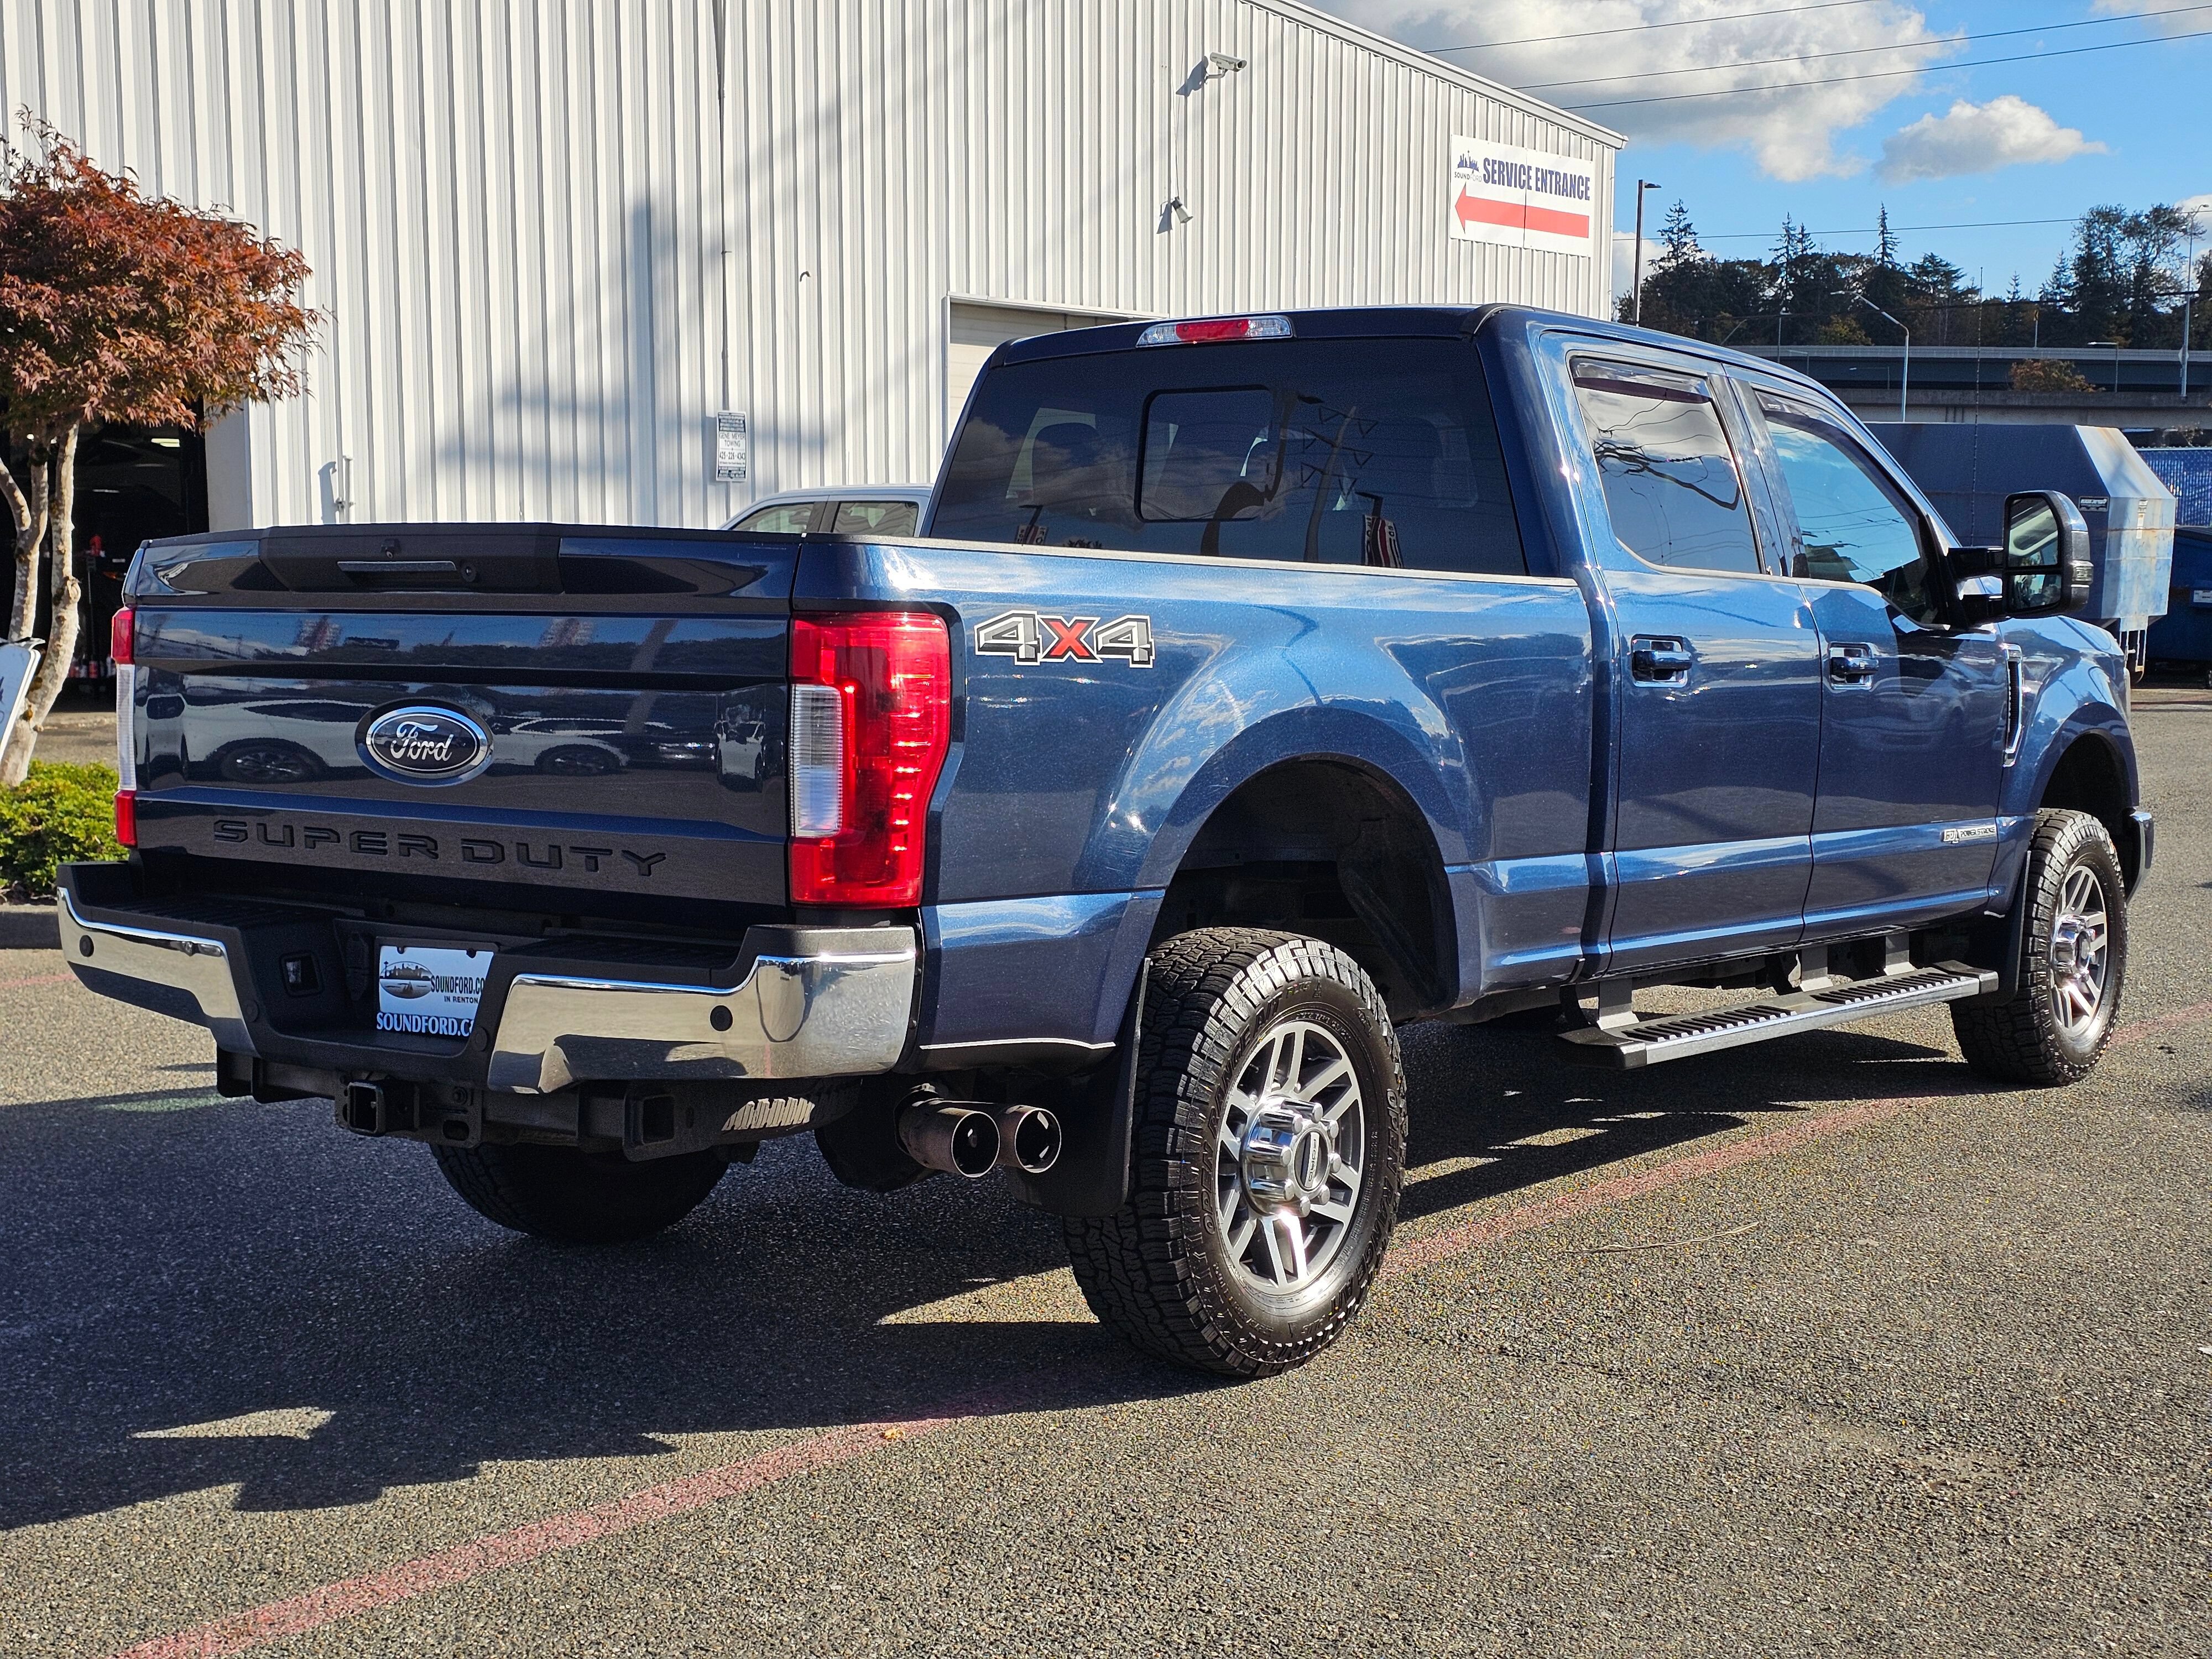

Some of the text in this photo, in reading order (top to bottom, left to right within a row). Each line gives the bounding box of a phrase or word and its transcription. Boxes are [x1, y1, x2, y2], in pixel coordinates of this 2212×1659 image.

[1483, 158, 1590, 201] SERVICE ENTRANCE
[390, 720, 452, 762] Ford
[213, 819, 666, 877] SUPER DUTY
[452, 996, 478, 1004] RENTON
[1308, 1138, 1317, 1182] FORD
